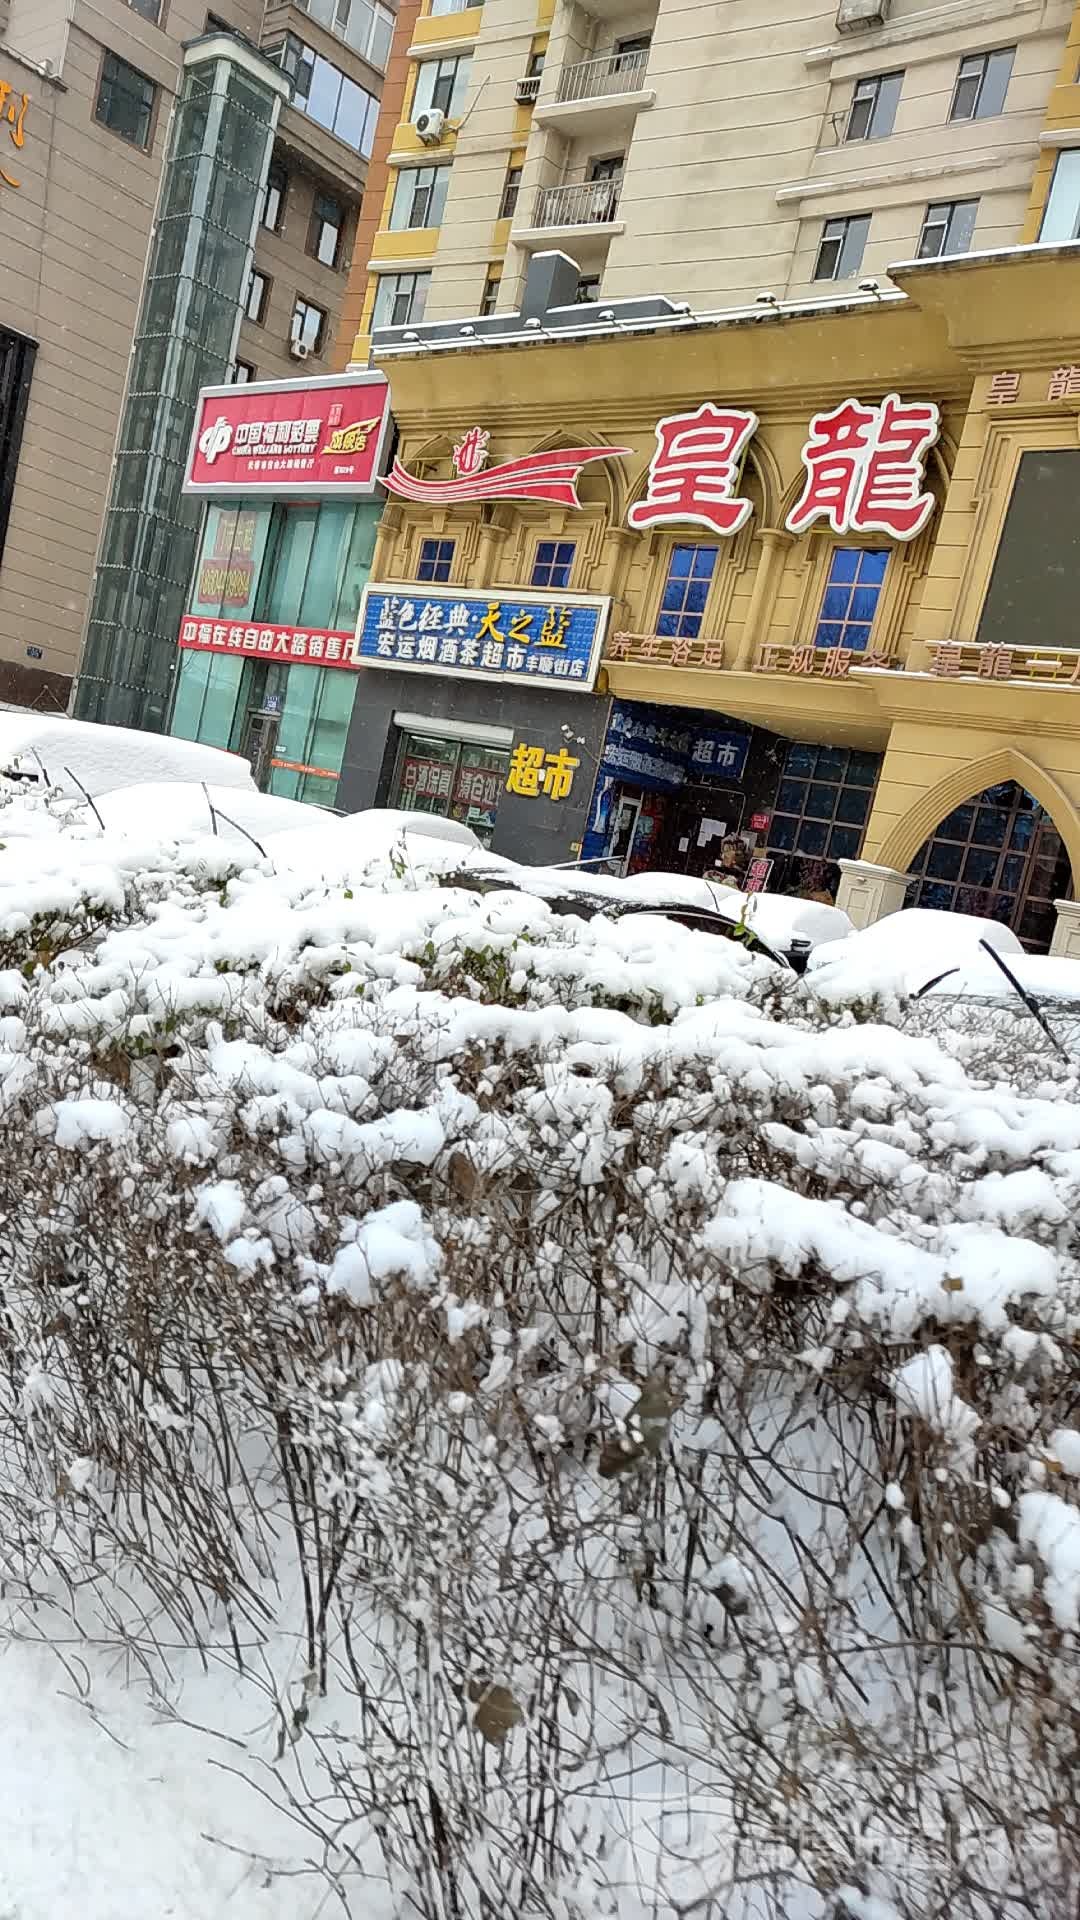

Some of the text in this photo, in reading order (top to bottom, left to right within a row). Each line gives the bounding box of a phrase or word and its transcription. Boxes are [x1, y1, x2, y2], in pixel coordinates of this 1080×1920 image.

[235, 419, 323, 444] 中国福利彩票
[691, 738, 739, 767] 超市
[506, 743, 581, 801] 超市
